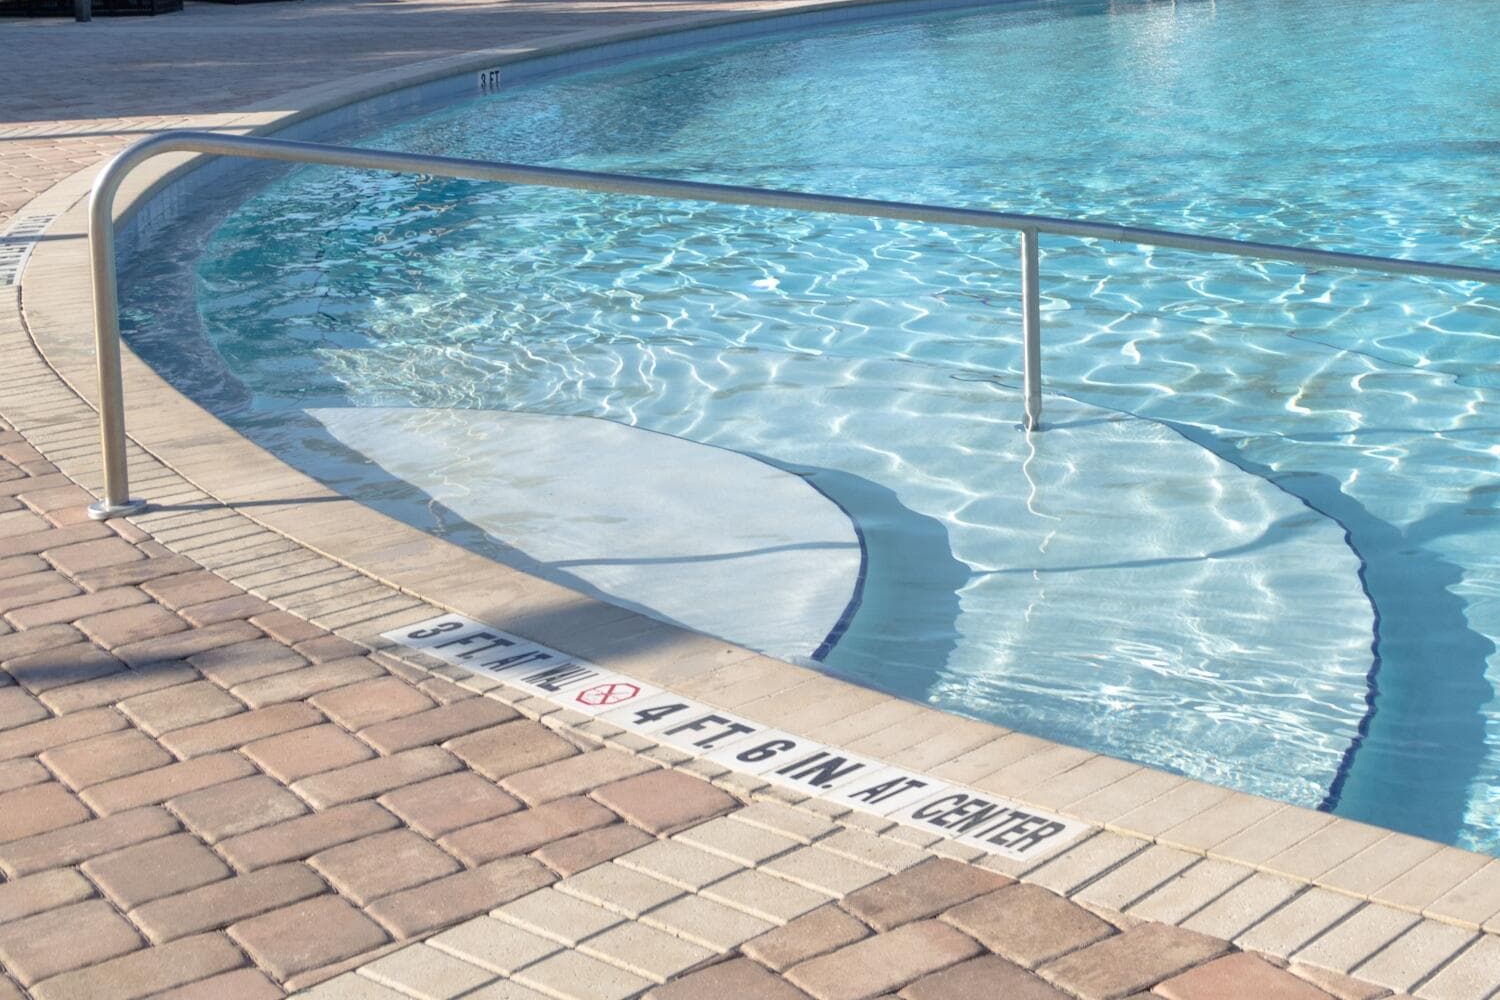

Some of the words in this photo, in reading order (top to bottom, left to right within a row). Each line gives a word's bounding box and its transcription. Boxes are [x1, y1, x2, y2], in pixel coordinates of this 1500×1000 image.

[489, 70, 500, 90] FT
[408, 621, 463, 639] 3
[434, 631, 515, 660] FT.
[480, 650, 553, 672] AT
[520, 662, 600, 692] WALL
[632, 703, 690, 725] 4
[663, 714, 756, 749] FT.
[736, 739, 797, 763] 6
[775, 751, 866, 789] IN.
[848, 776, 928, 805] AT
[911, 793, 1067, 853] CENTER
